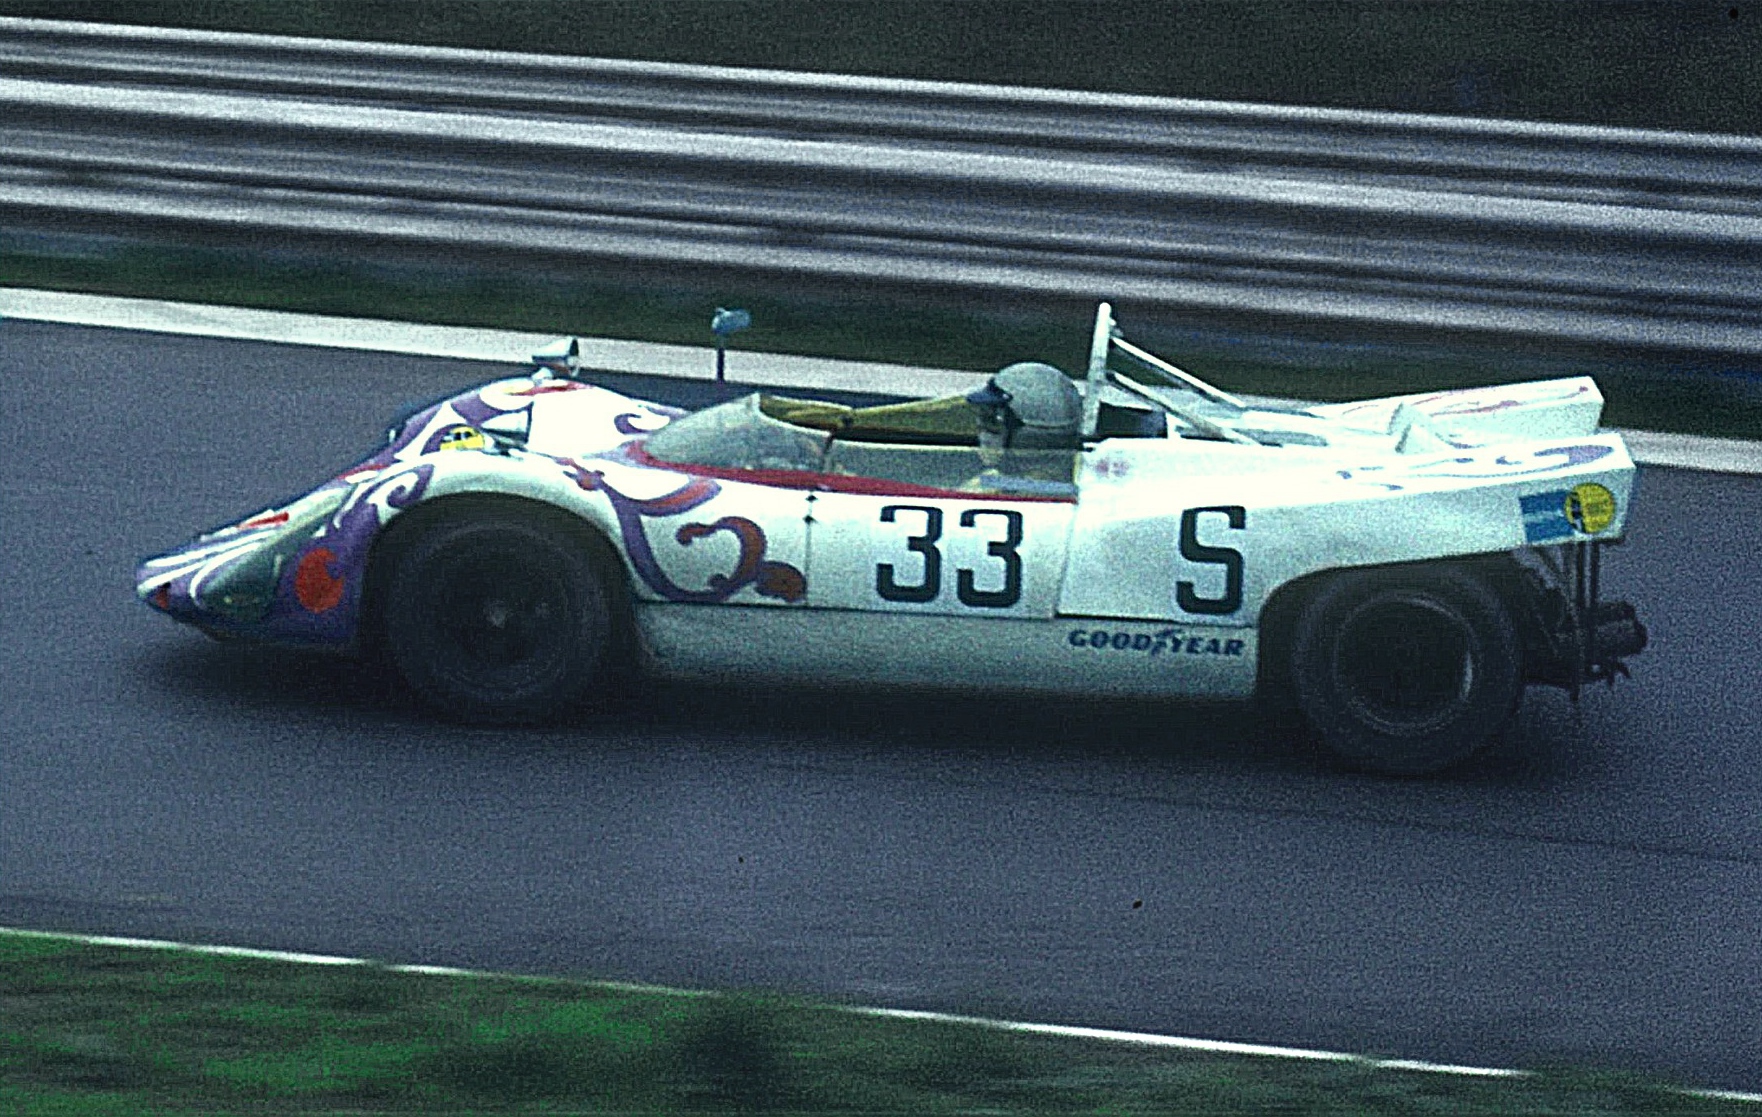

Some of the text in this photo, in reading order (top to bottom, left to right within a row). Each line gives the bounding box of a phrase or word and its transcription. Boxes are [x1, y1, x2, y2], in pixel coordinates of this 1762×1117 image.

[876, 505, 1023, 608] 33
[1175, 505, 1247, 615] S
[1068, 629, 1245, 657] GOODYEAR
